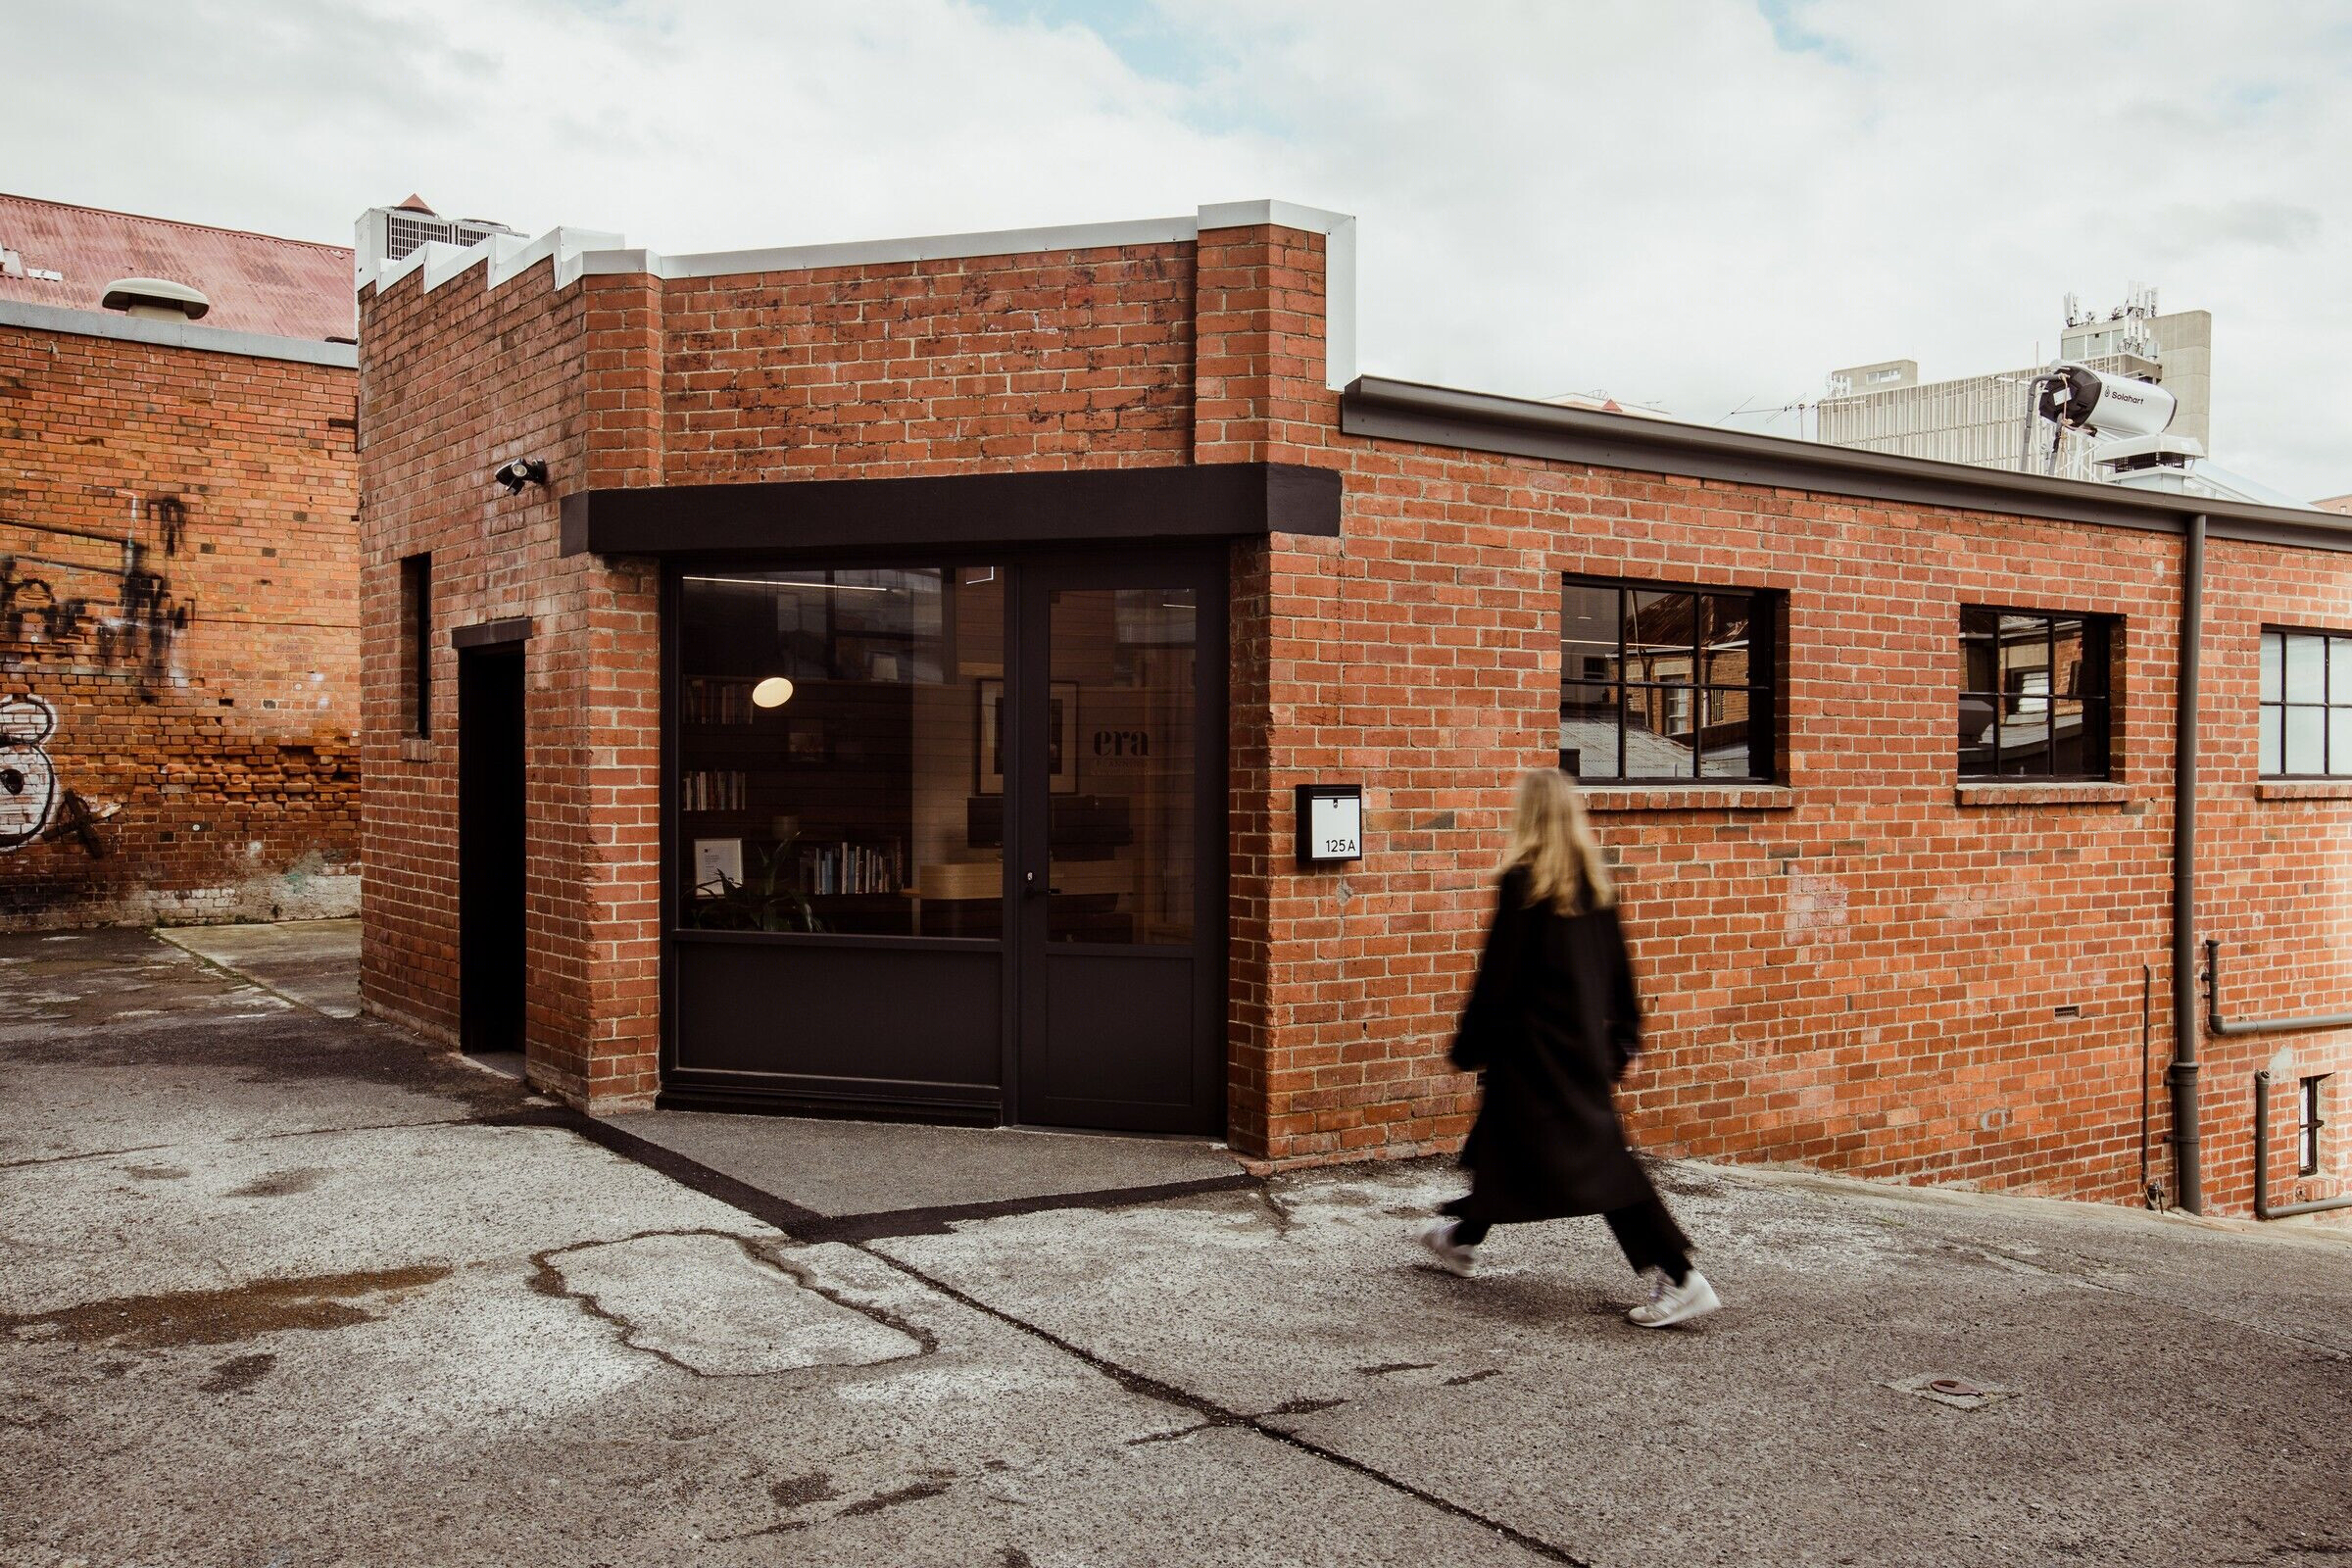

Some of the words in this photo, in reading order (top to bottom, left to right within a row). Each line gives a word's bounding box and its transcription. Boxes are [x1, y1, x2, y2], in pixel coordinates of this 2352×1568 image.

[2112, 391, 2144, 405] Solahart
[1094, 730, 1150, 757] era
[1325, 839, 1356, 853] 125A
